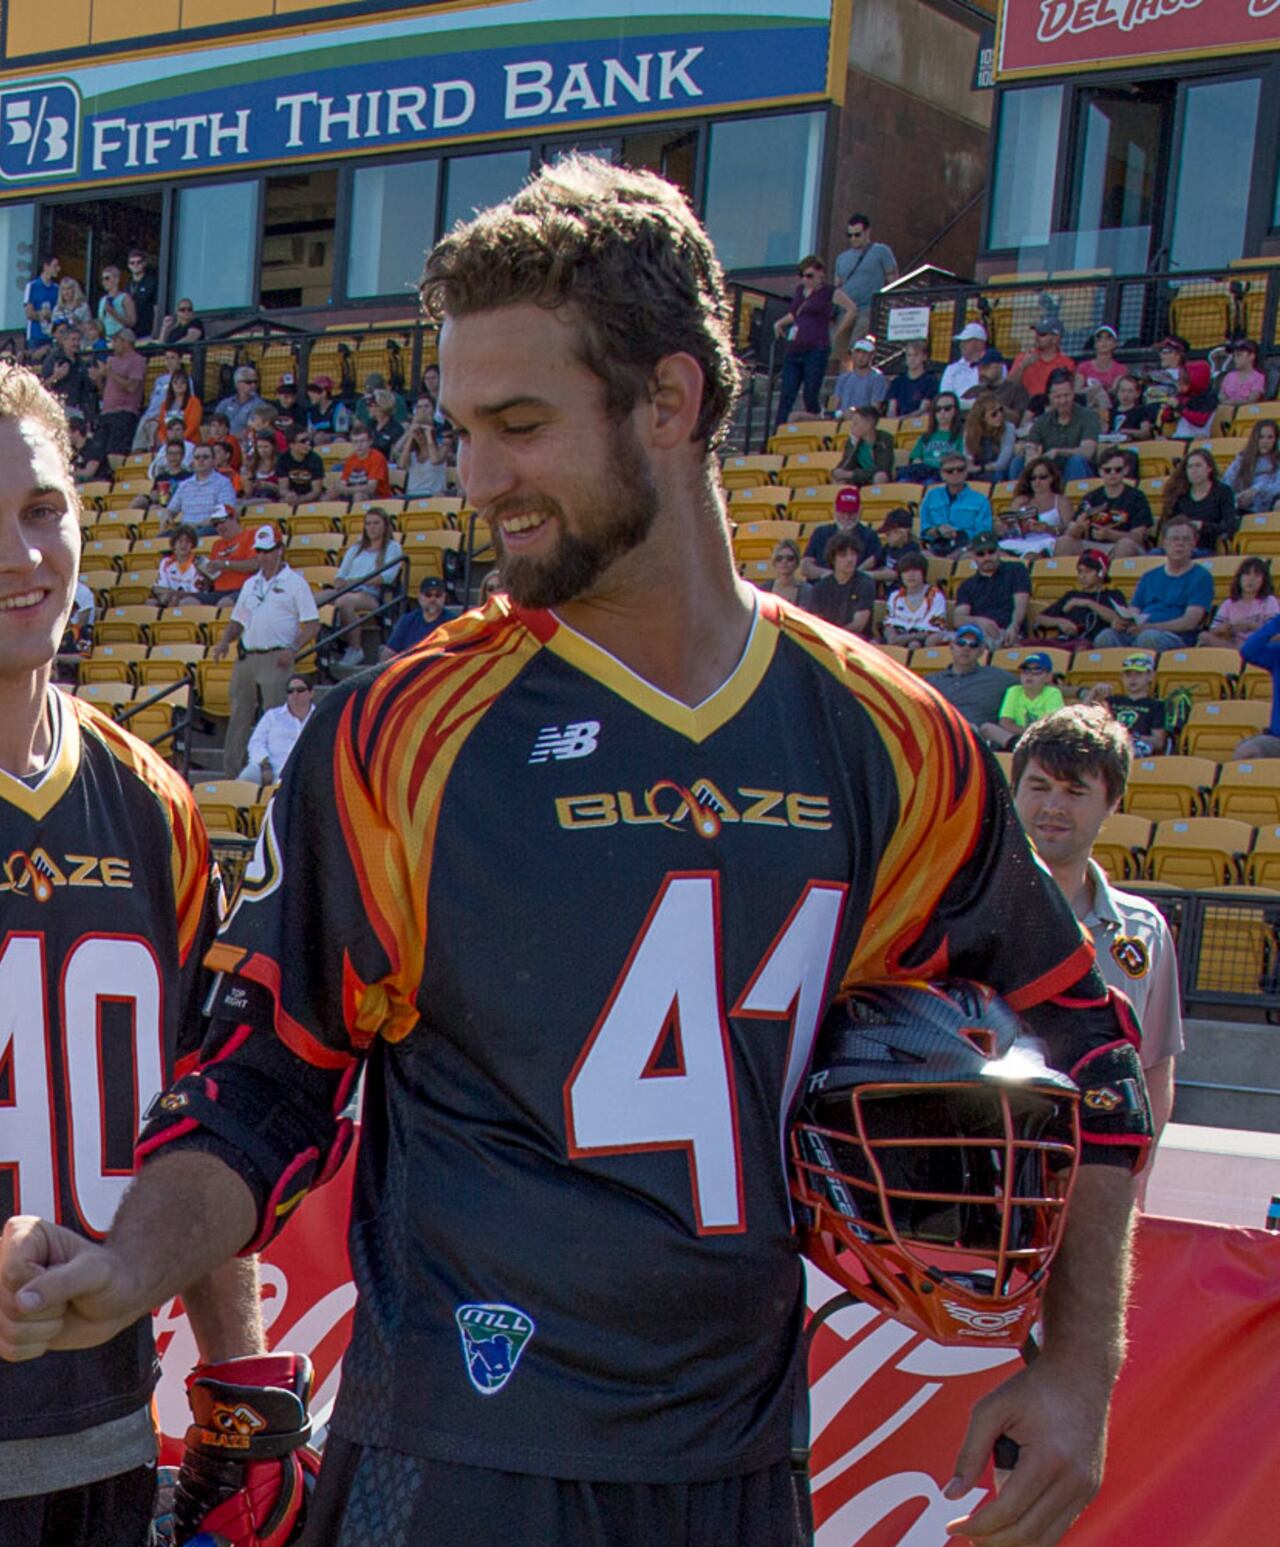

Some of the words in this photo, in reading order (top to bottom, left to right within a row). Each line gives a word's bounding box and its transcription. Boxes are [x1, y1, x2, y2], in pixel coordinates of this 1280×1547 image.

[91, 108, 252, 171] FIFTH
[276, 78, 476, 148] THIRD
[503, 45, 706, 119] BANK
[554, 778, 834, 840] BLAZE
[562, 869, 851, 1236] 41
[462, 1308, 528, 1332] MLL
